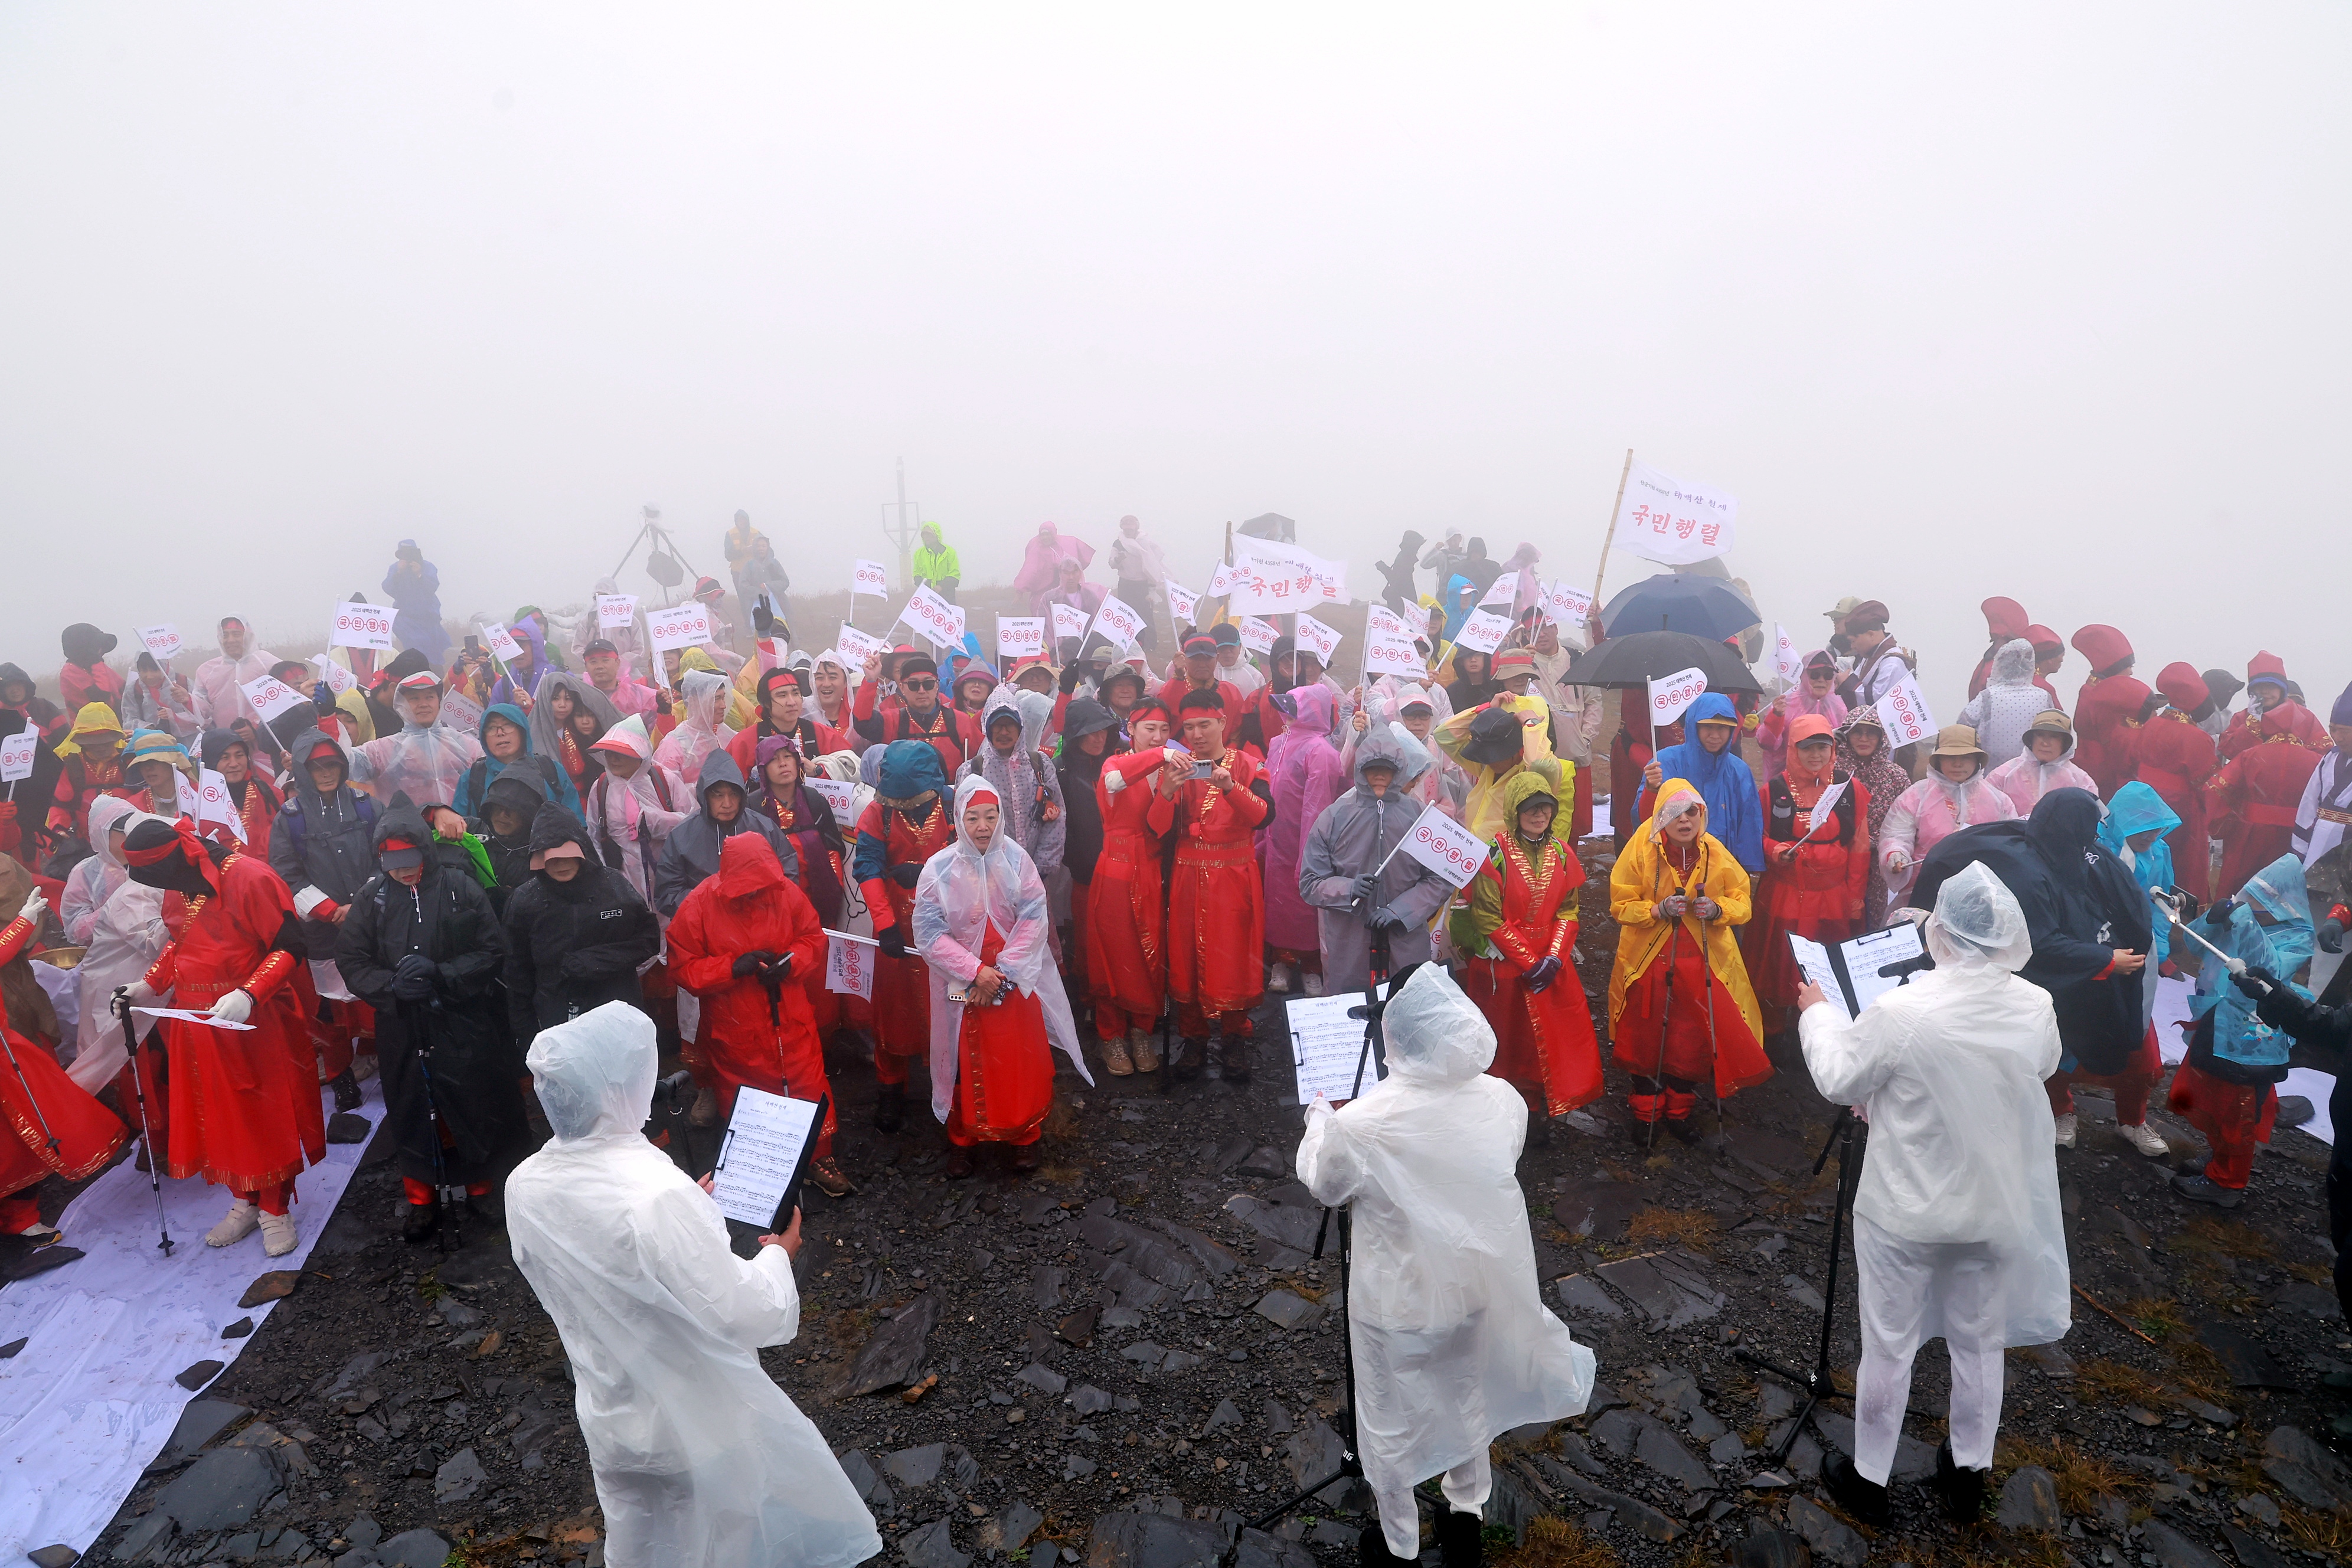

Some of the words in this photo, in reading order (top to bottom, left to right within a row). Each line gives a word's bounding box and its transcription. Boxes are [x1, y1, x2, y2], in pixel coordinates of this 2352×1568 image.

[1674, 491, 1704, 504] 태백산
[1632, 505, 1720, 546] 국민행렬
[1555, 596, 1585, 610] 국민행
[912, 599, 954, 633] 국민행렬
[339, 618, 387, 631] 국민행렬
[655, 620, 704, 635] 국민행렬
[1002, 632, 1039, 640] 국민행렬
[1373, 649, 1411, 660] 국민행
[256, 680, 268, 689] 2025
[1657, 683, 1706, 706] 국민행렬
[1909, 690, 1917, 701] 2025
[1891, 687, 1919, 736] 국민행렬
[1442, 822, 1453, 832] 2025
[1453, 831, 1465, 840] 태백산
[1465, 837, 1474, 847] 천제
[1419, 829, 1475, 871] 국민행렬
[1447, 870, 1465, 883] 태백문화원
